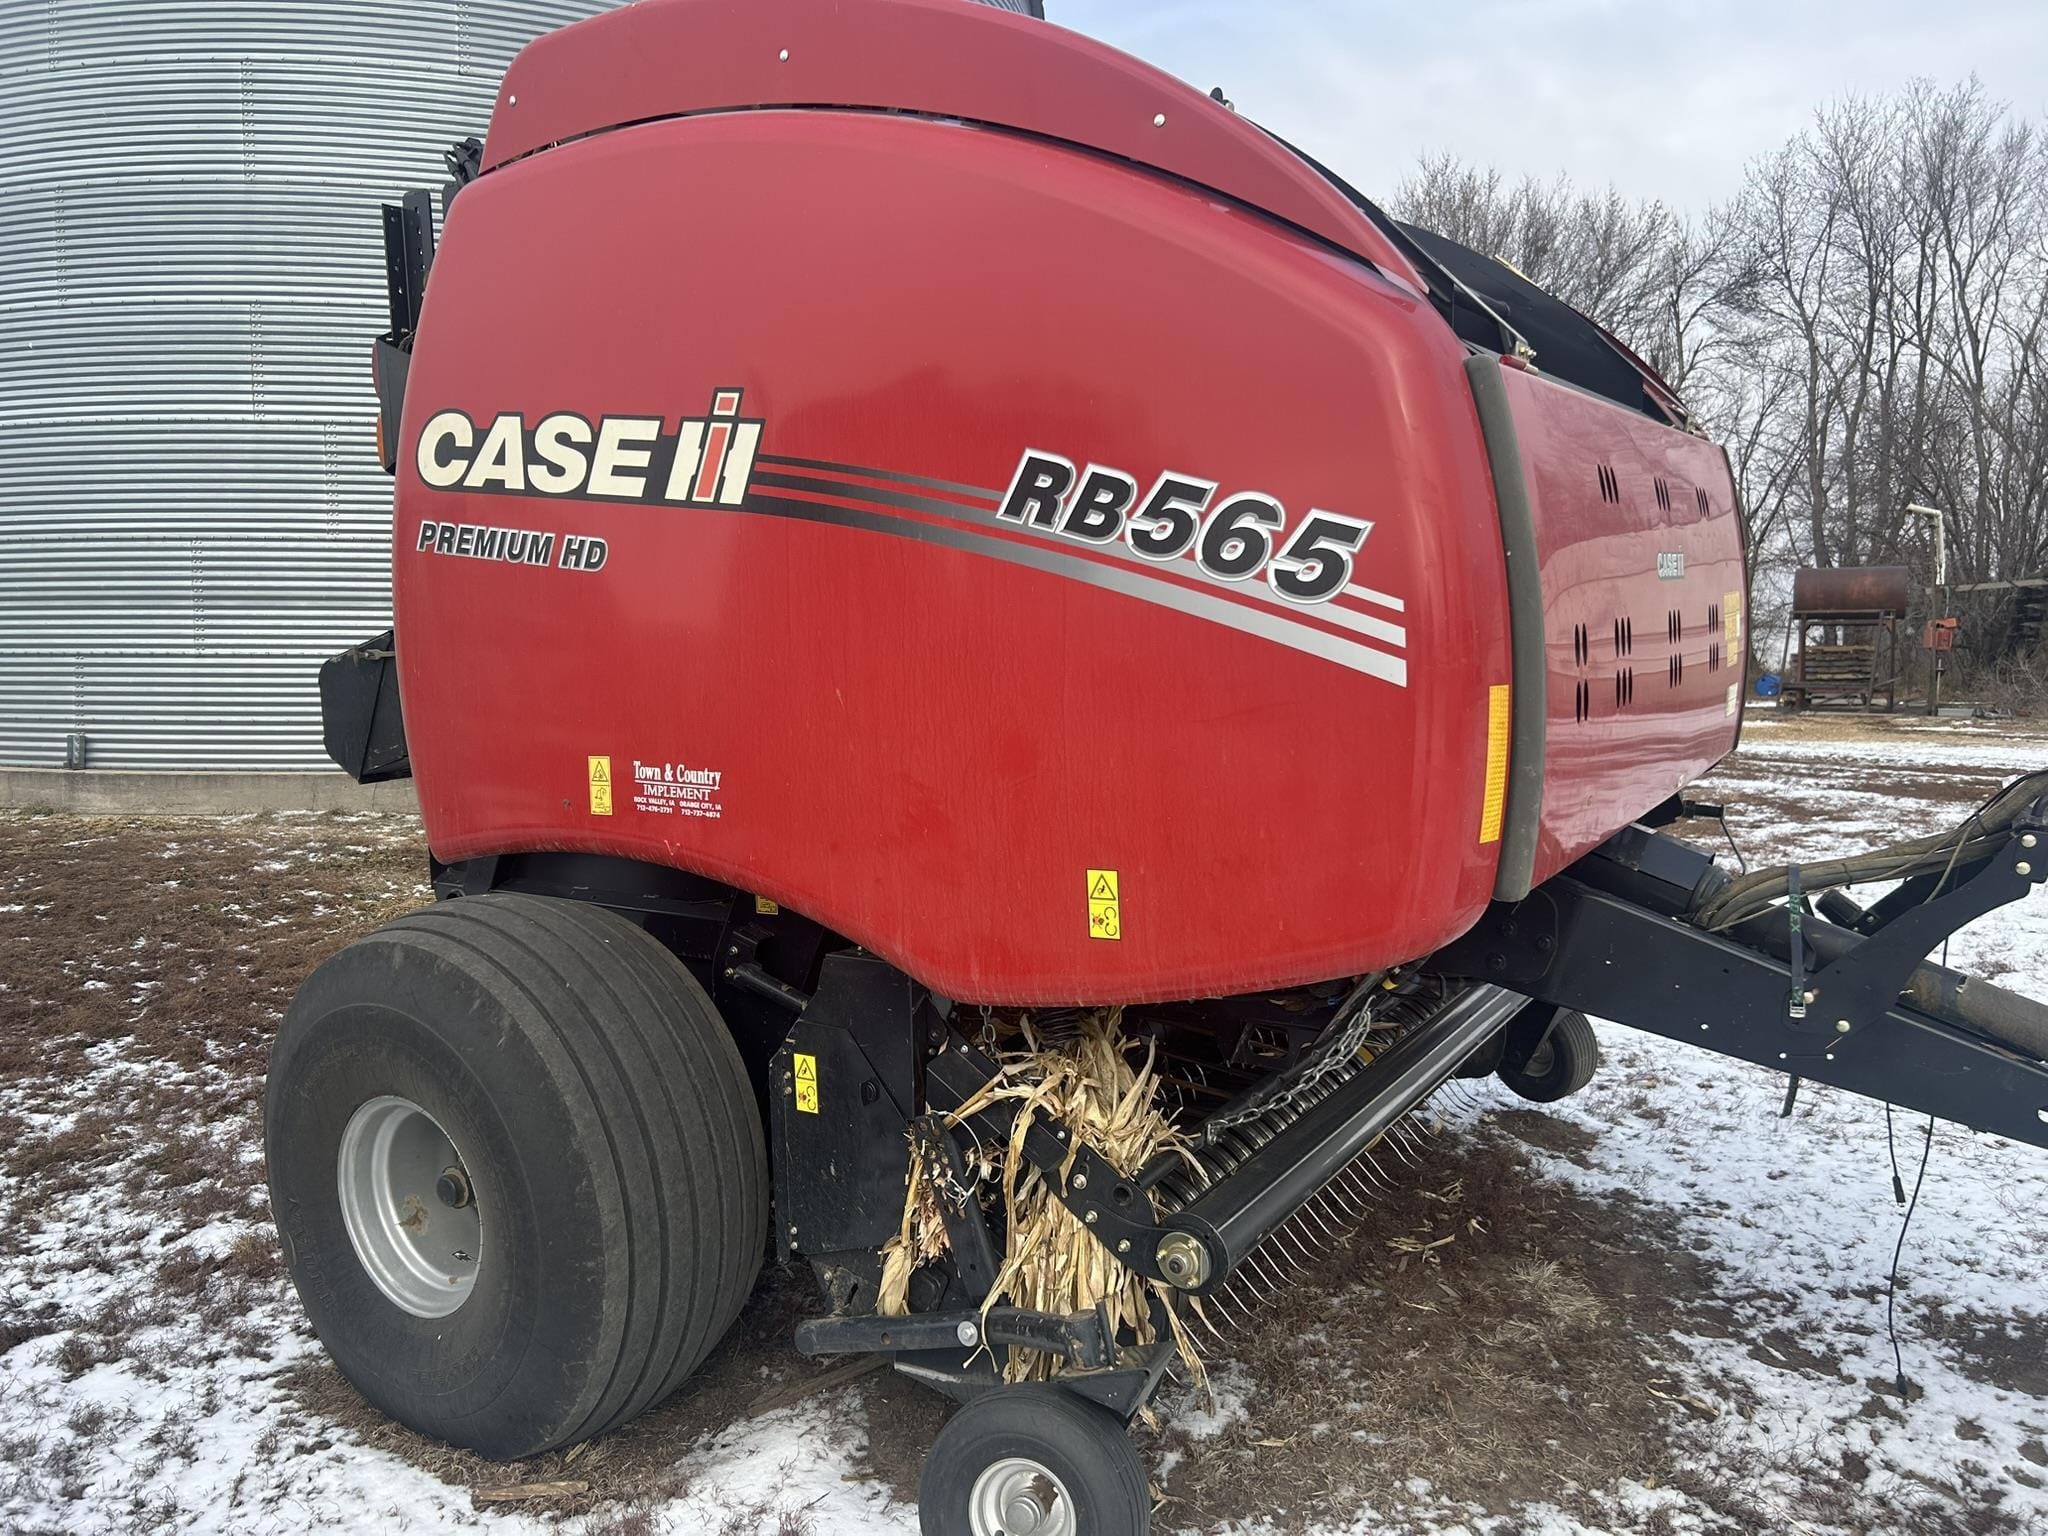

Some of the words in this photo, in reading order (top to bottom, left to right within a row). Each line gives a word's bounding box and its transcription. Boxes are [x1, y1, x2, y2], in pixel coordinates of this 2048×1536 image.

[416, 411, 662, 498] CASE
[416, 520, 554, 567] PREMIUM
[558, 534, 608, 571] HD
[996, 447, 1376, 604] RB565
[1657, 553, 1677, 577] CASE
[633, 760, 661, 780] Town
[664, 763, 673, 781] &
[676, 764, 721, 790] Country
[643, 784, 711, 801] IMPLEMENT
